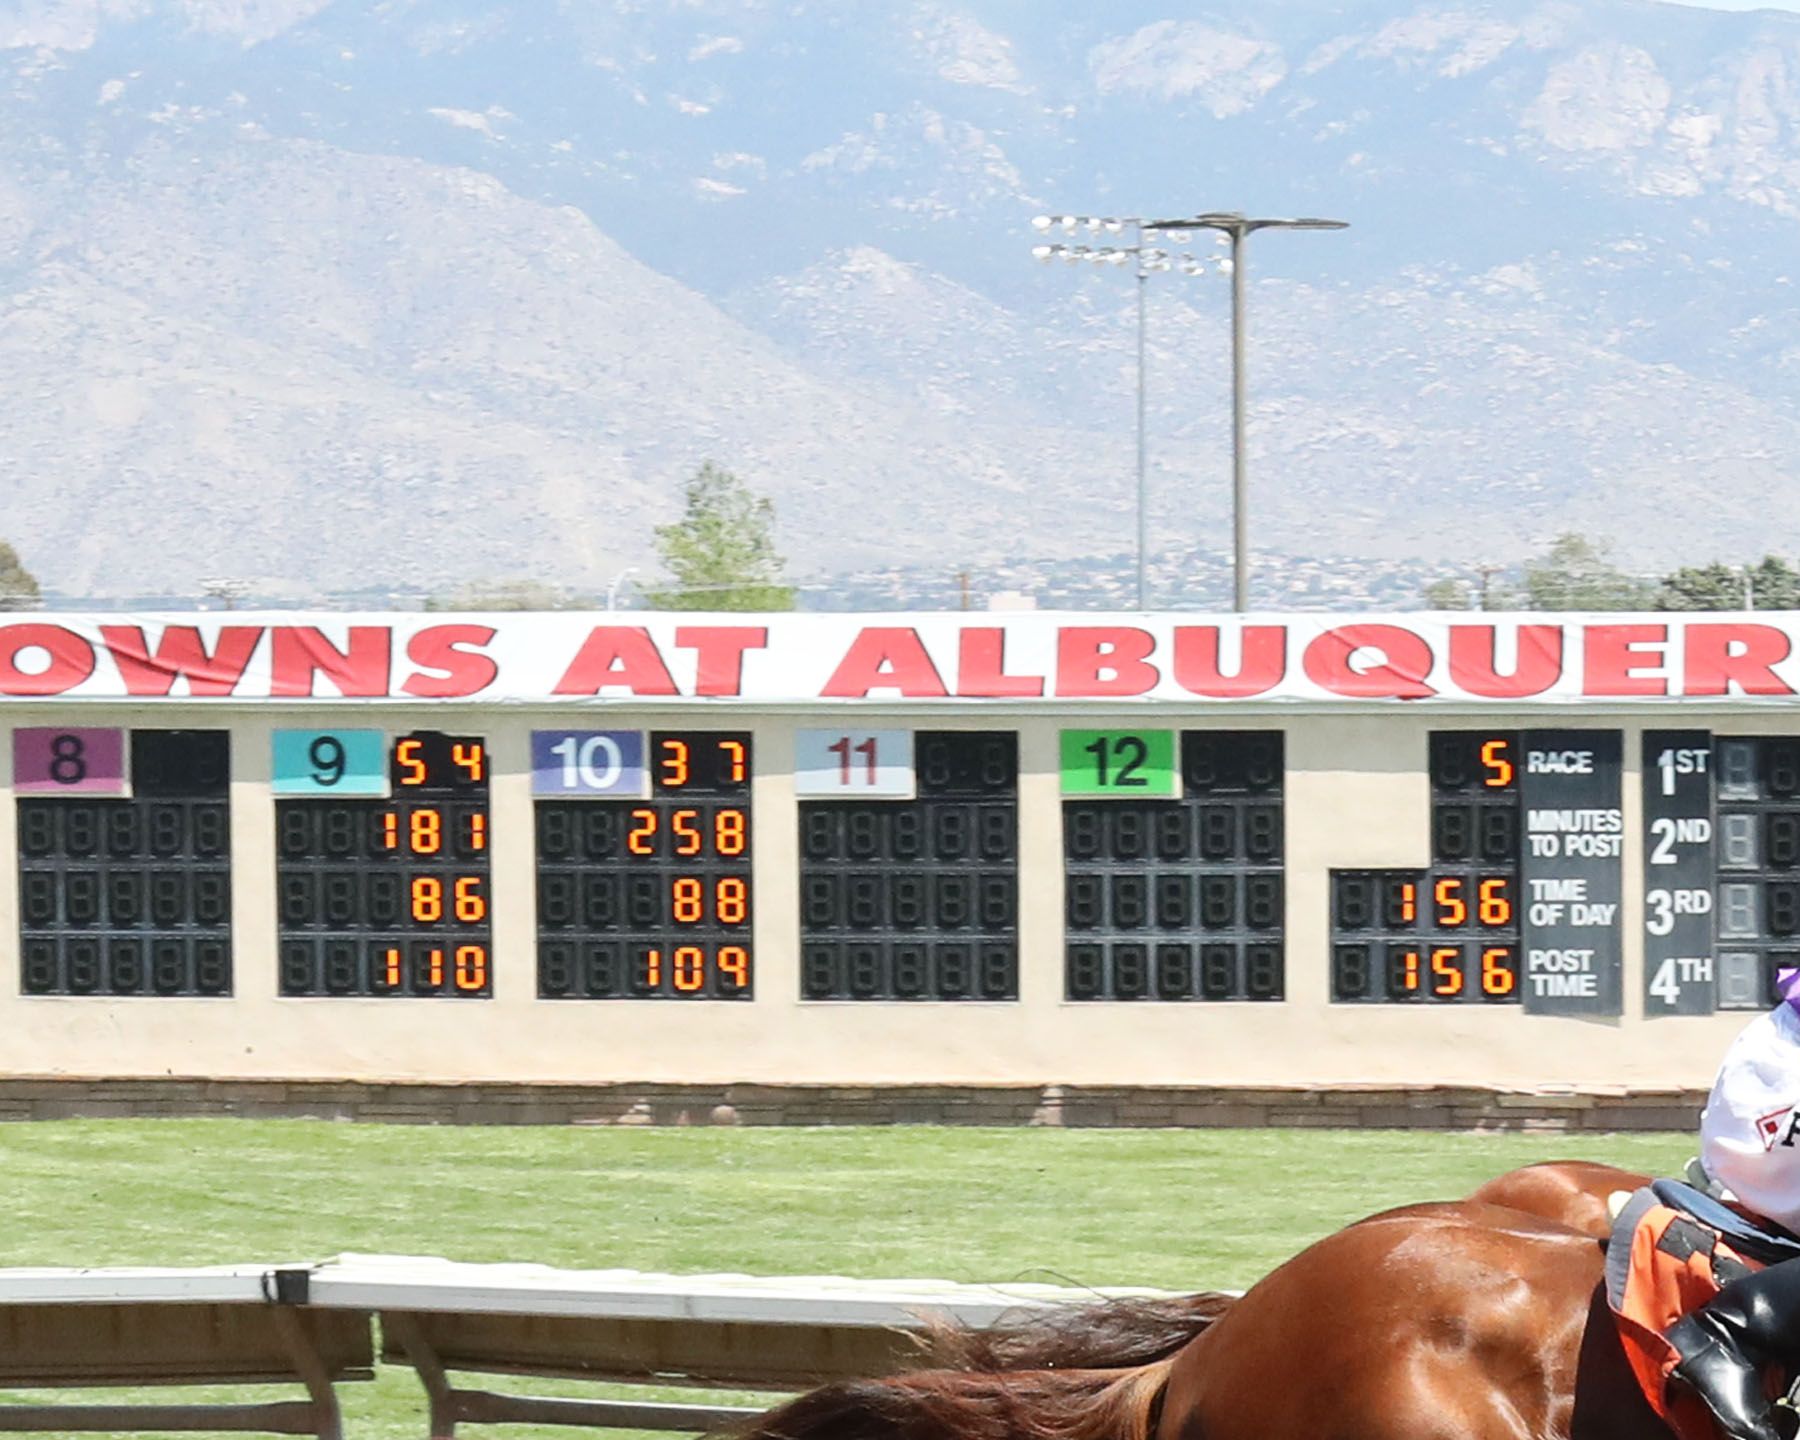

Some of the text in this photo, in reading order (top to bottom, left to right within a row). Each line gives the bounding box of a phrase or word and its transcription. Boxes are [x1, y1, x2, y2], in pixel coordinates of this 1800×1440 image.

[553, 624, 768, 697] AT
[49, 734, 86, 784] 8
[309, 736, 346, 786] 9
[551, 736, 622, 789] 10
[827, 736, 877, 787] 11
[1084, 735, 1148, 786] 12
[1481, 740, 1512, 786] 5
[1527, 751, 1594, 774] RACE
[1658, 749, 1710, 796] 1ST
[384, 809, 484, 854] 181
[629, 810, 745, 855] 258
[1527, 808, 1622, 833] MINUTES
[1650, 818, 1712, 865] 2ND
[1527, 833, 1622, 858] TO POST
[412, 877, 485, 921] 86
[673, 878, 745, 923] 88
[1402, 879, 1510, 924] 156
[1528, 878, 1588, 902] TIME
[1645, 889, 1712, 936] 3RD
[1528, 903, 1618, 927] OF DAY
[386, 946, 485, 990] 110
[648, 947, 747, 990] 109
[1406, 949, 1513, 994] 156
[1528, 948, 1596, 973] POST
[1649, 957, 1713, 1006] 4TH
[1528, 973, 1599, 997] TIME
